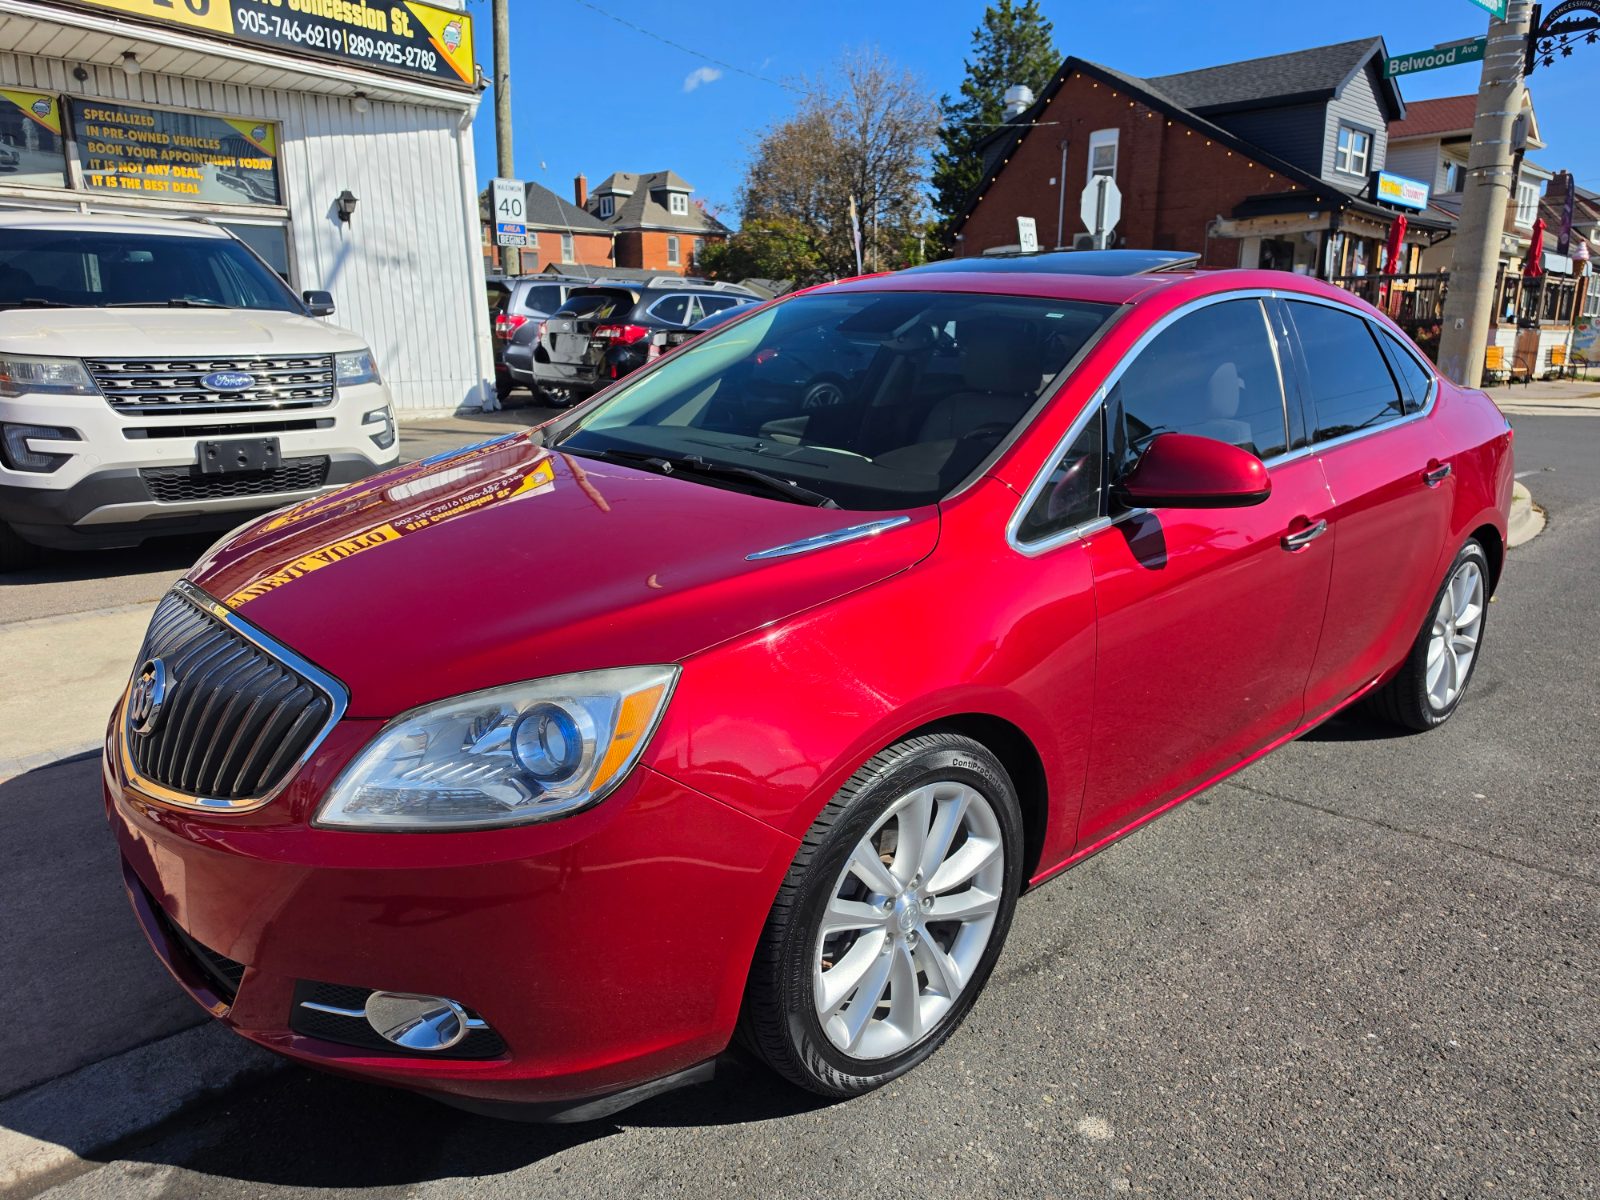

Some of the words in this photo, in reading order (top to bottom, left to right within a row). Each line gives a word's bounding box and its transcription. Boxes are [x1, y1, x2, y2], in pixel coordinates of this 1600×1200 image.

[390, 7, 414, 38] St.
[1550, 1, 1593, 20] CONCESSION
[237, 8, 342, 51] 905-746-6219
[348, 33, 437, 72] 289-925-2782
[1388, 48, 1456, 74] Belwood
[1461, 43, 1478, 55] Ave
[83, 108, 155, 127] SPECIALIZED
[85, 125, 99, 137] IN
[102, 127, 171, 145] PRE-OWNED
[172, 135, 221, 150] VEHICLES
[87, 142, 123, 156] BOOK
[126, 145, 158, 159] YOUR
[160, 150, 236, 168] APPOINTMENT
[238, 157, 273, 171] TODAY
[89, 158, 101, 170] IT
[104, 160, 116, 171] IS
[117, 162, 143, 173] NOT
[145, 163, 170, 176] ANY
[172, 165, 204, 181] DEAL,
[92, 174, 103, 187] IT
[105, 175, 118, 188] IS
[119, 176, 142, 190] THE
[144, 178, 170, 192] BEST
[172, 180, 200, 195] DEAL
[499, 198, 522, 217] 40
